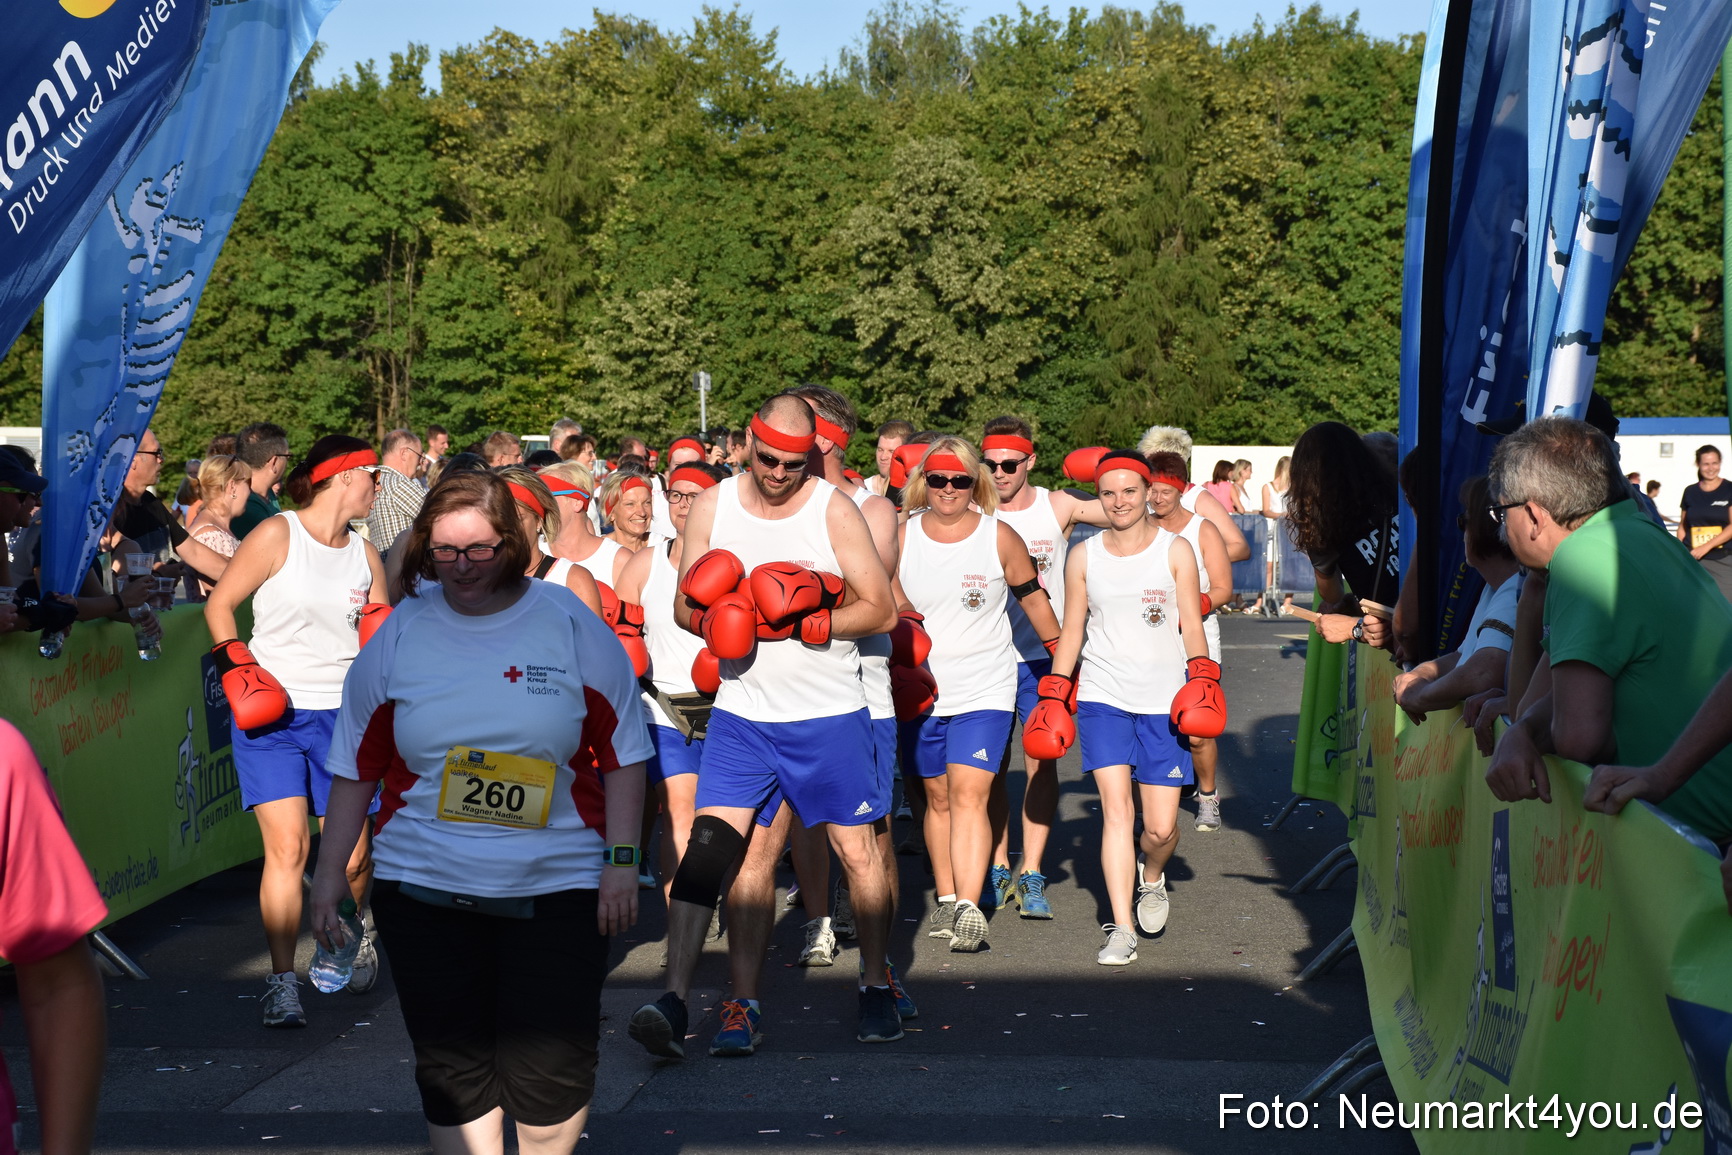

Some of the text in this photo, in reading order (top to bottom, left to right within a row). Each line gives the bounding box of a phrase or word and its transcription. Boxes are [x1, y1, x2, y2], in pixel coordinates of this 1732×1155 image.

[8, 145, 70, 235] Druck
[61, 82, 104, 149] und
[1142, 596, 1156, 604] POWER
[526, 664, 566, 674] Bayerisches
[527, 686, 560, 696] Nadine
[462, 777, 526, 812] 260
[202, 792, 242, 832] neumark
[462, 804, 524, 820] Wagner Nadine
